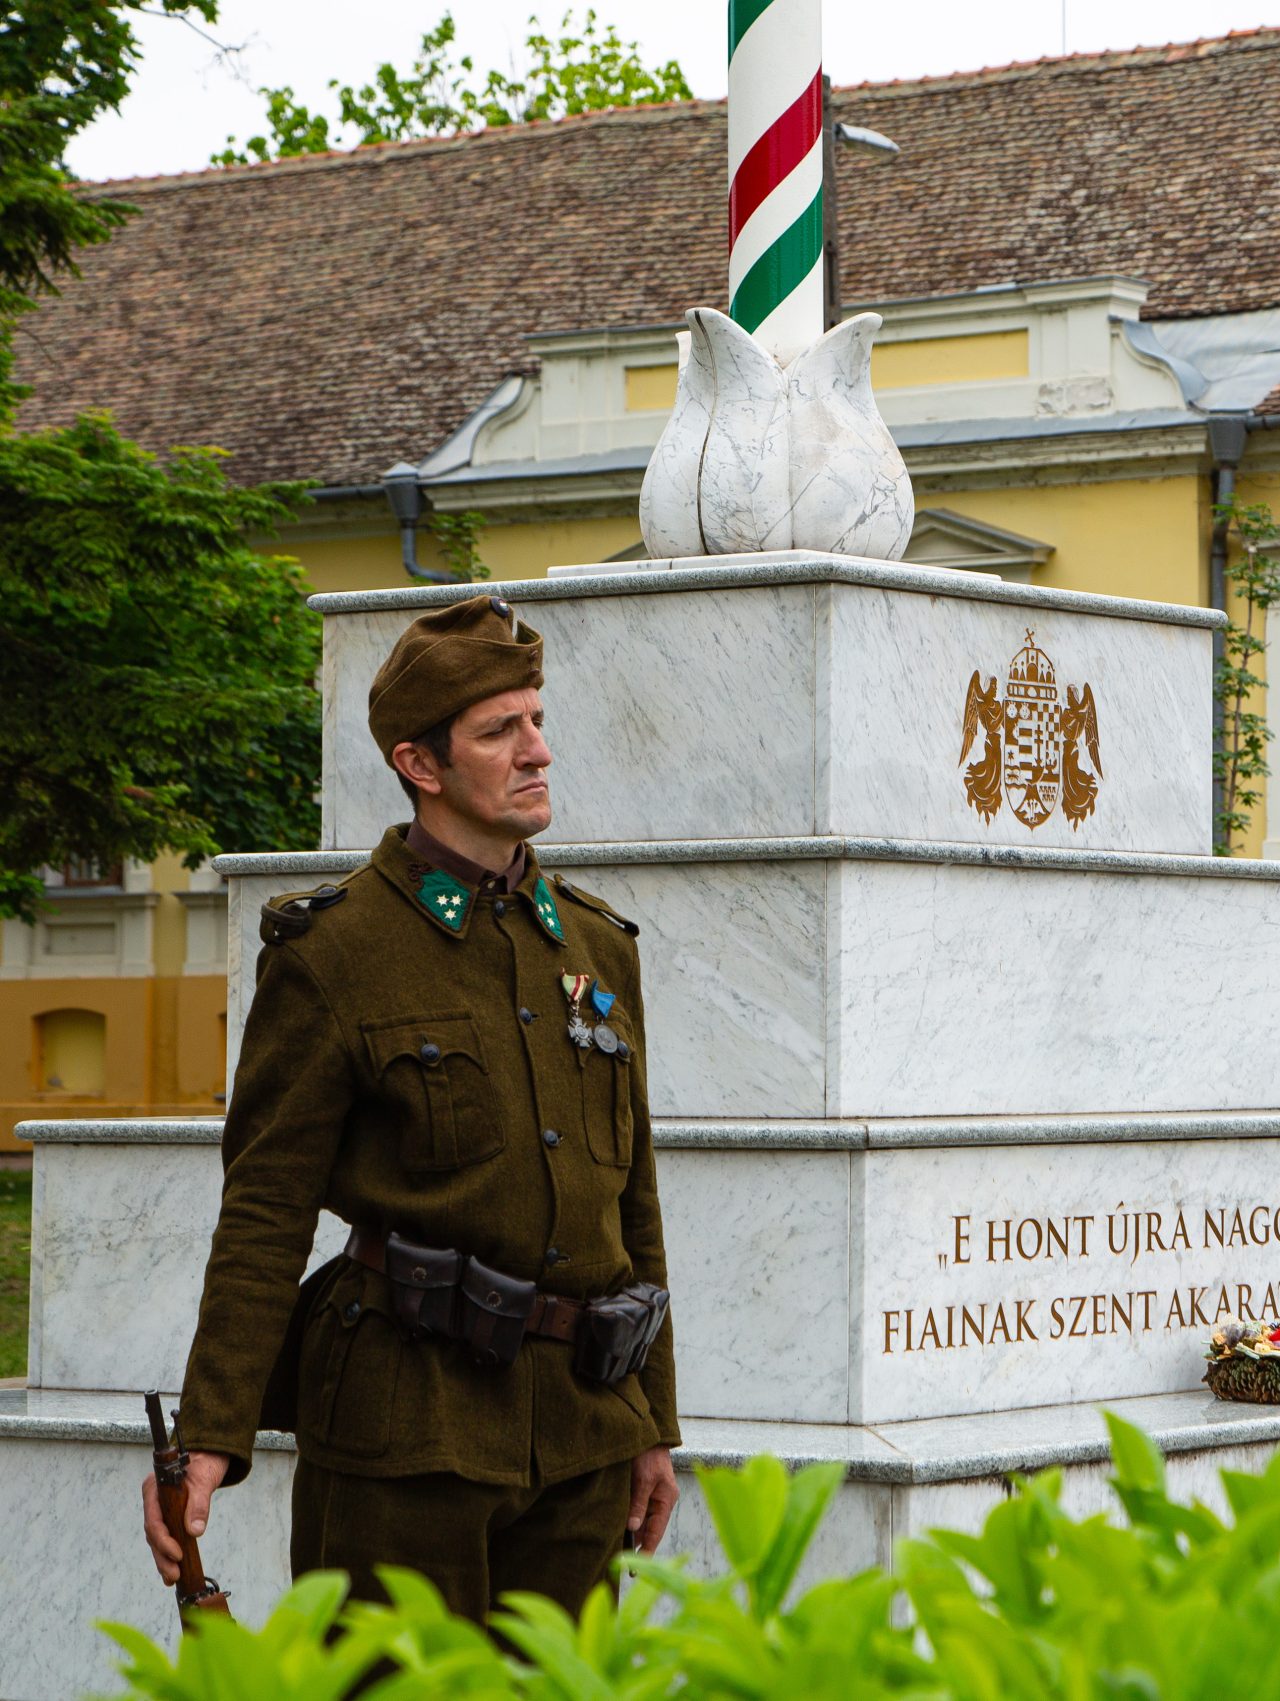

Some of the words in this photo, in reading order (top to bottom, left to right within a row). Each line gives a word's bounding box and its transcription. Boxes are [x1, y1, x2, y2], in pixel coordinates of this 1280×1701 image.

[986, 1216, 1095, 1264] HONT
[1106, 1200, 1193, 1267] ÚJRA
[882, 1299, 1040, 1354] FIAINAK
[1050, 1290, 1158, 1341] SZENT
